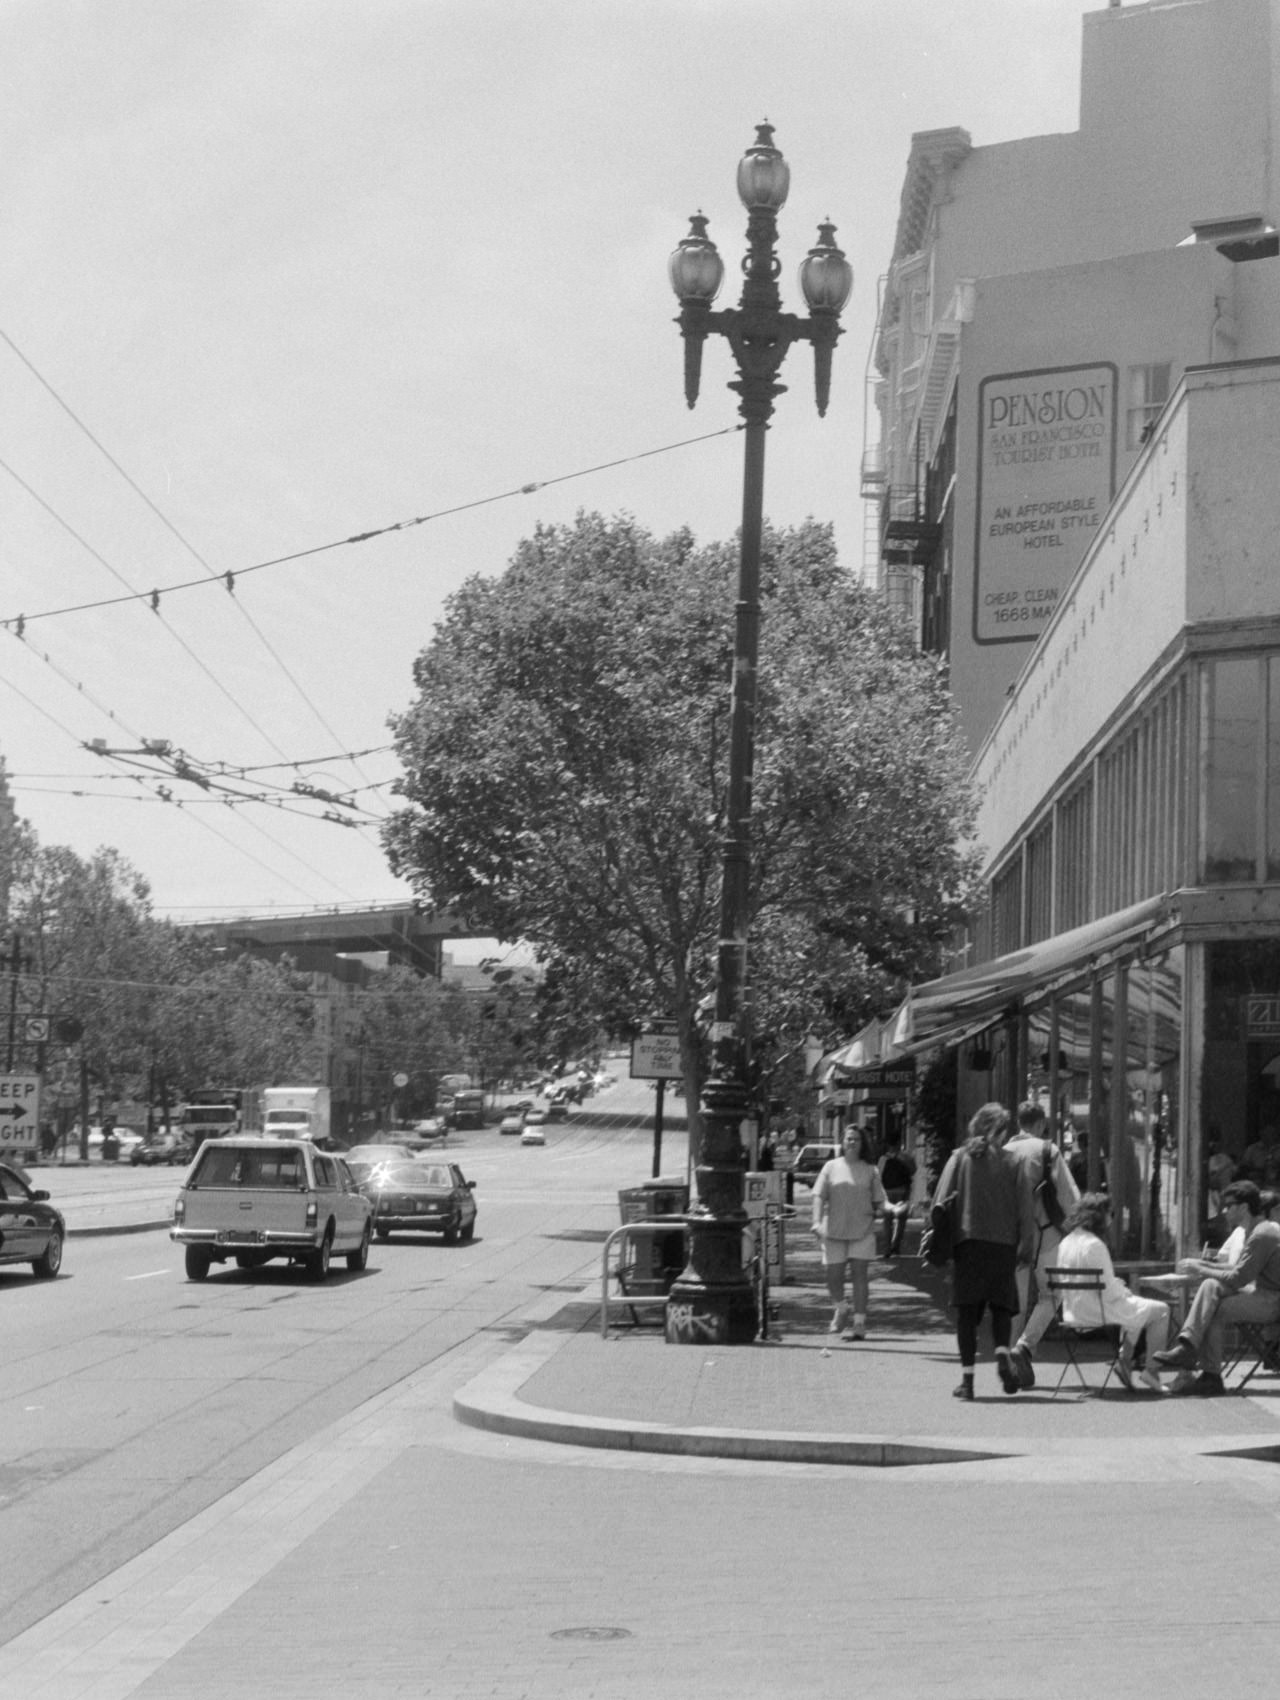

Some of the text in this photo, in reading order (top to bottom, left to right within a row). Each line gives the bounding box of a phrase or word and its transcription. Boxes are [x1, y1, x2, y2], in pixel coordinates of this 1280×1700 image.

[988, 385, 1107, 430] PENSION
[991, 423, 1105, 449] SAN FRANCISCO
[993, 442, 1100, 466] TOURIST HOTEL
[994, 497, 1096, 521] AN AFFORDABLE
[989, 513, 1100, 537] EUROPEAN STYLE
[1023, 534, 1065, 550] HOTEL
[1024, 587, 1059, 602] CLEAN
[993, 605, 1056, 623] 1668 MA
[640, 1045, 681, 1055] STOPPIN
[656, 1038, 671, 1047] NO
[0, 1083, 35, 1098] EEP
[0, 1124, 36, 1140] GHT
